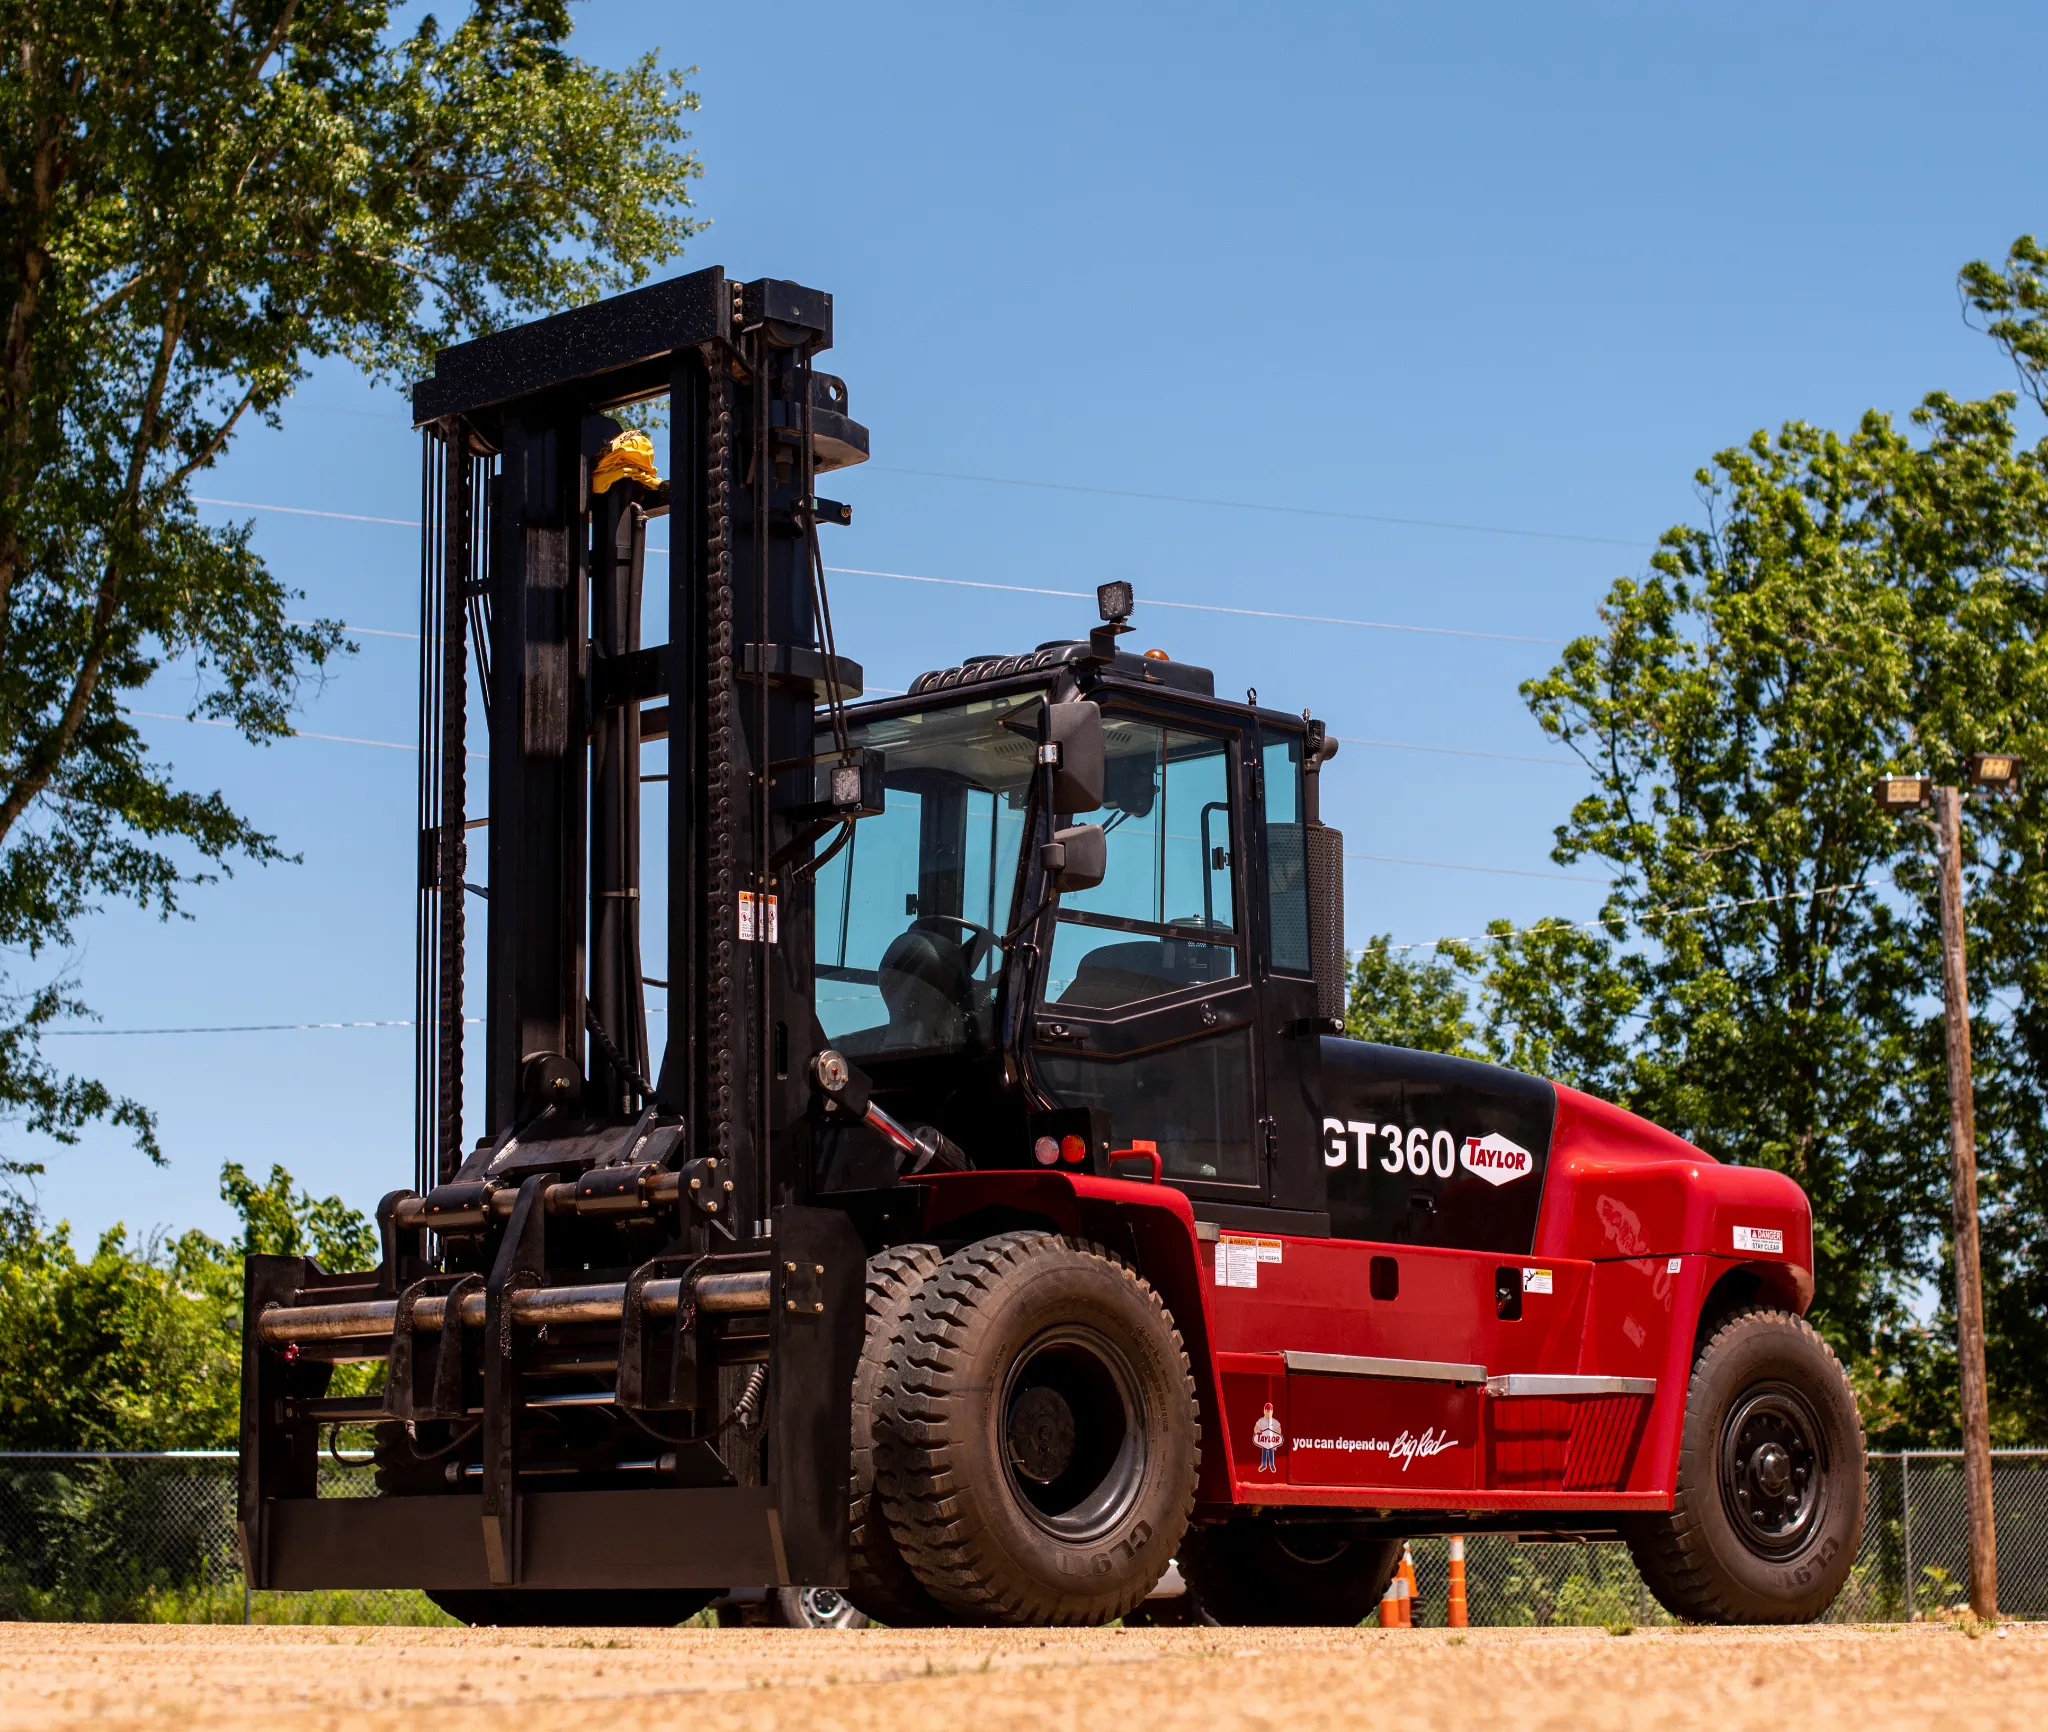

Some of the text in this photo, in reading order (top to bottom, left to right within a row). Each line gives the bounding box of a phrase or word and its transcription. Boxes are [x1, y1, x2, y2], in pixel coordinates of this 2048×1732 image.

[1467, 1138, 1526, 1170] TAYLOR
[1758, 1230, 1781, 1240] DANGER
[1256, 1432, 1280, 1444] TAYLOR
[1293, 1426, 1458, 1472] you can depend on Big Red
